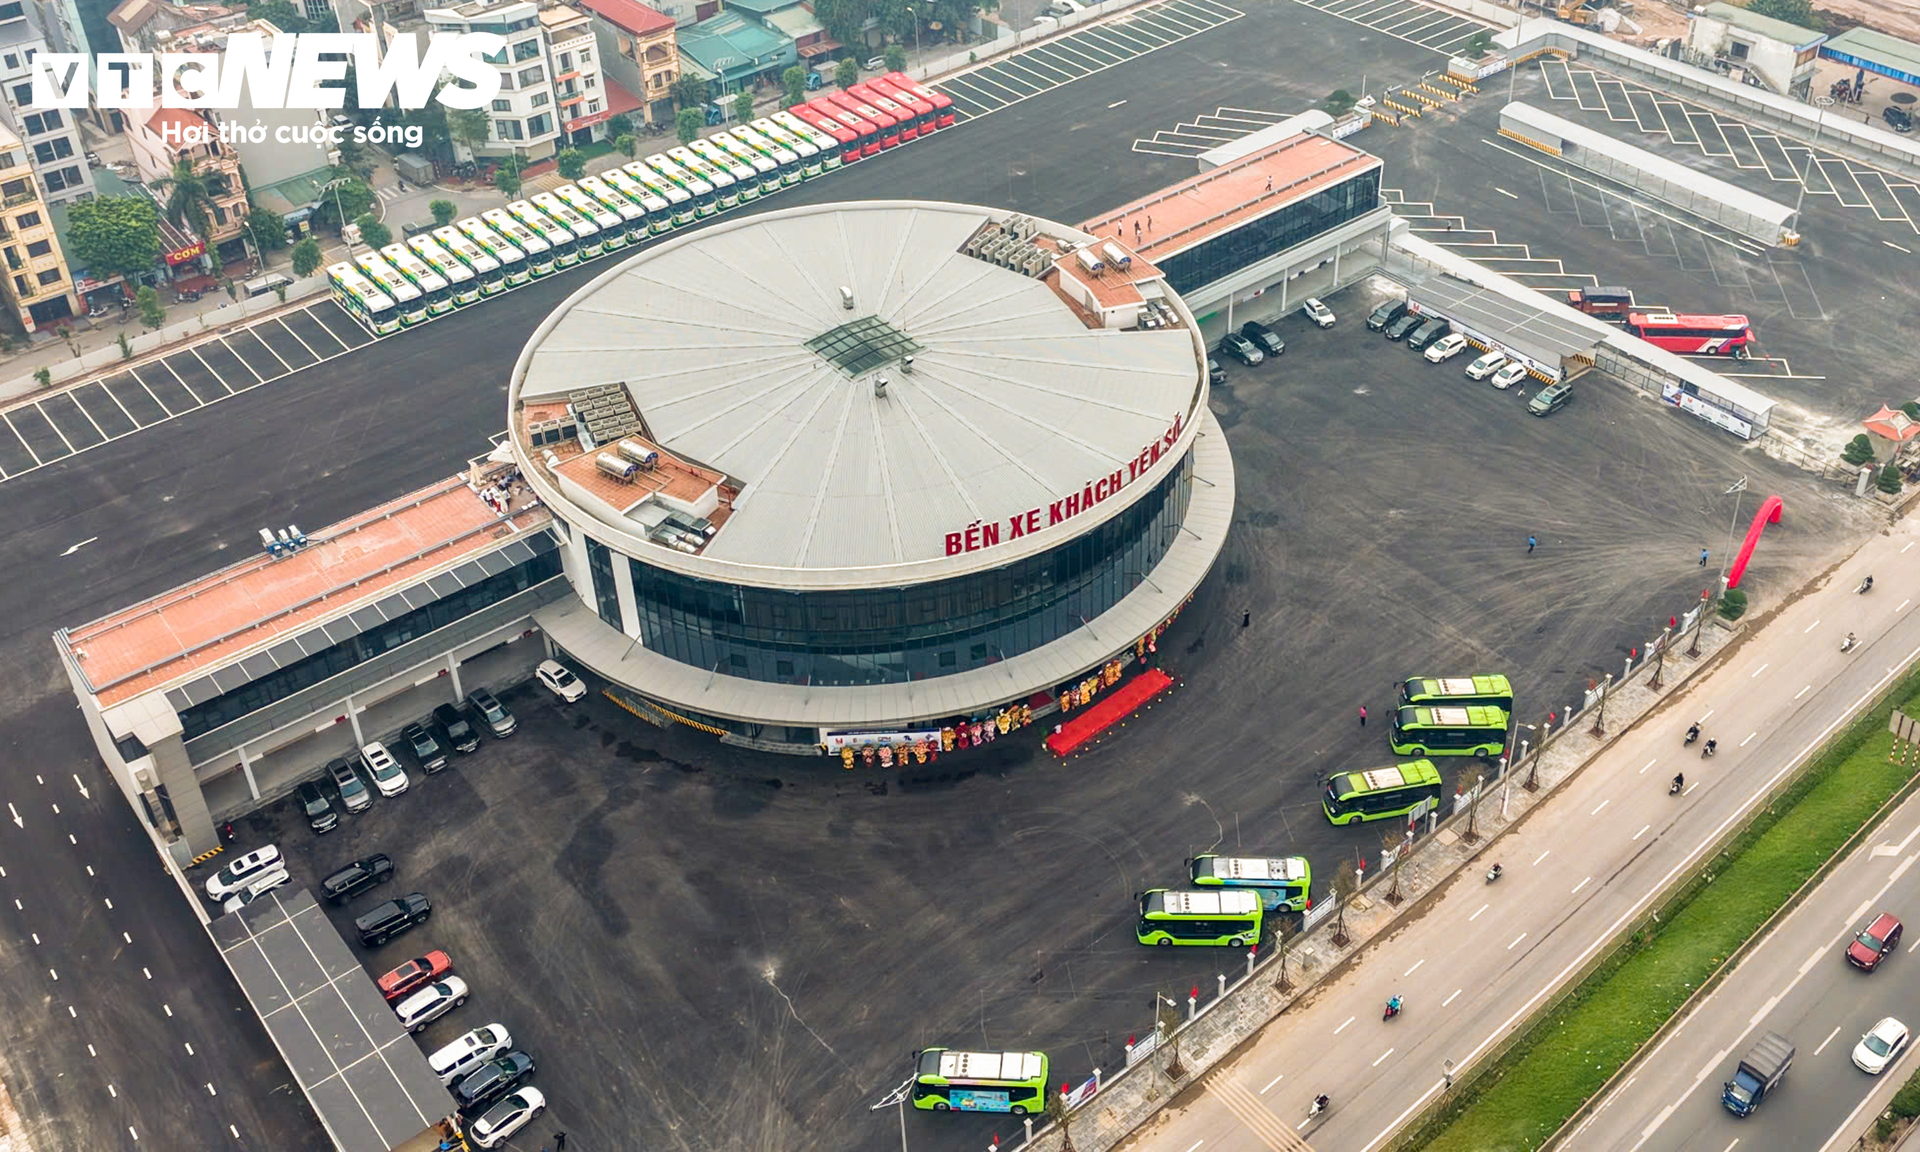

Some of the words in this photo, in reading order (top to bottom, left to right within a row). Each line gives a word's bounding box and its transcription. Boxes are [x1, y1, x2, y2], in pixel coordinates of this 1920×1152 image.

[945, 519, 1000, 556] BẾN
[1009, 507, 1041, 541] XE
[1048, 468, 1123, 527] KHÁCH
[1128, 438, 1161, 483] YÊN
[1163, 411, 1182, 453] SỞ
